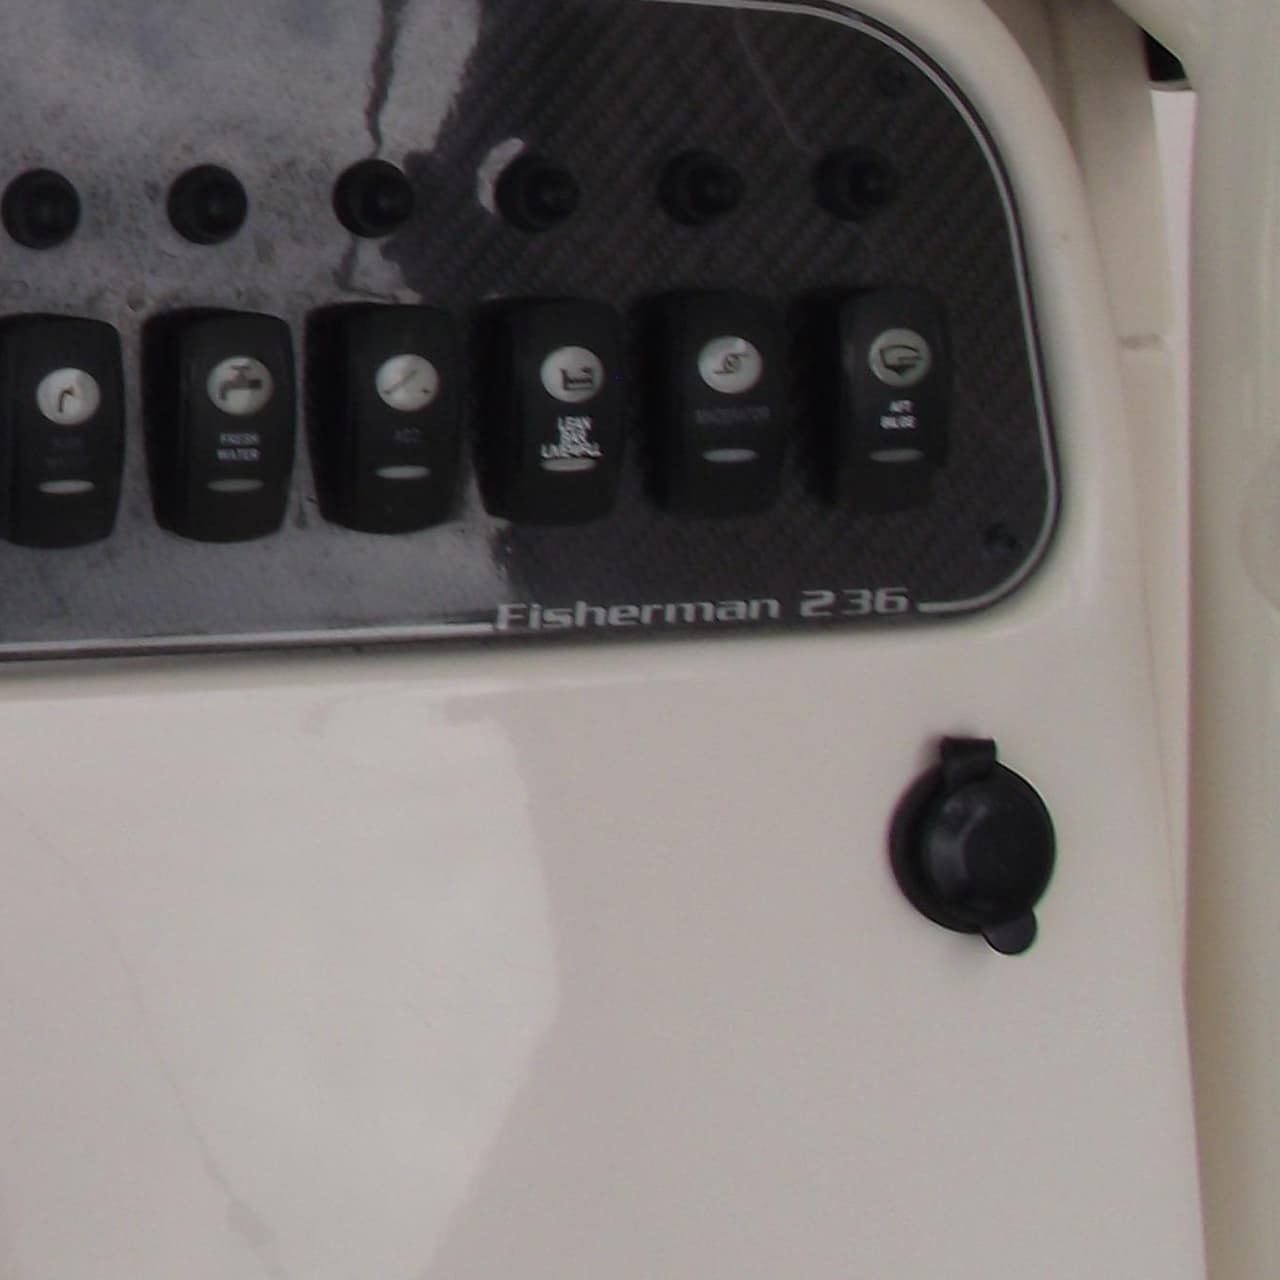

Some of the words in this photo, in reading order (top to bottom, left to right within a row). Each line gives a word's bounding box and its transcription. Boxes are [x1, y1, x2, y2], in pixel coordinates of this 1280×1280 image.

[216, 447, 262, 462] WATER
[495, 596, 780, 632] Fisherman
[799, 586, 909, 617] 236
